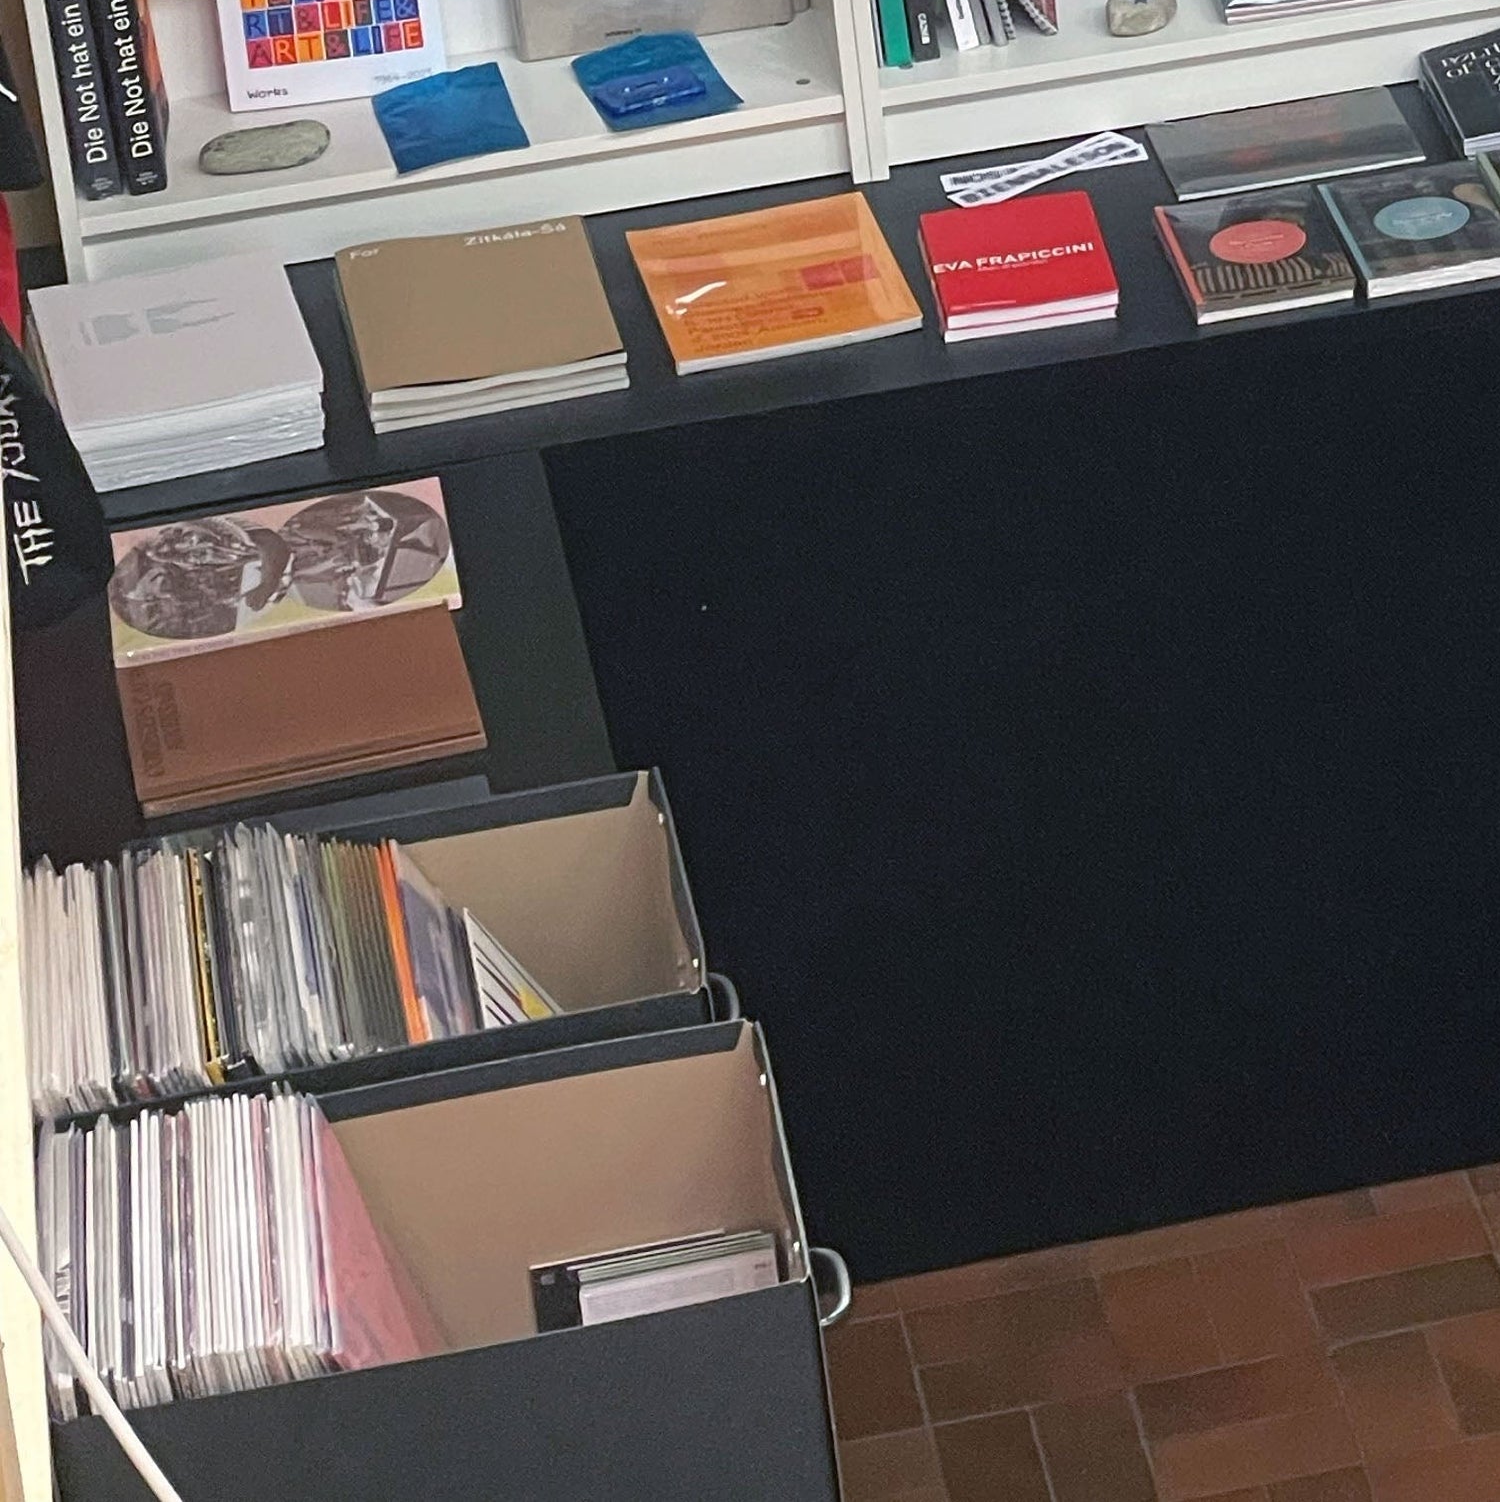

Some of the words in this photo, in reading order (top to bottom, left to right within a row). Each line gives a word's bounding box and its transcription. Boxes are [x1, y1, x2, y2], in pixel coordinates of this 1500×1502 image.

[61, 3, 84, 37] ein
[67, 41, 93, 79] hat
[113, 34, 138, 74] hat
[77, 82, 101, 122] Not
[122, 77, 147, 117] Not
[247, 87, 288, 99] Works
[84, 126, 108, 164] Die
[129, 119, 154, 159] Die
[350, 248, 379, 259] For
[933, 260, 973, 274] EVA
[976, 242, 1094, 267] FRAPICCINI
[13, 500, 54, 585] THE
